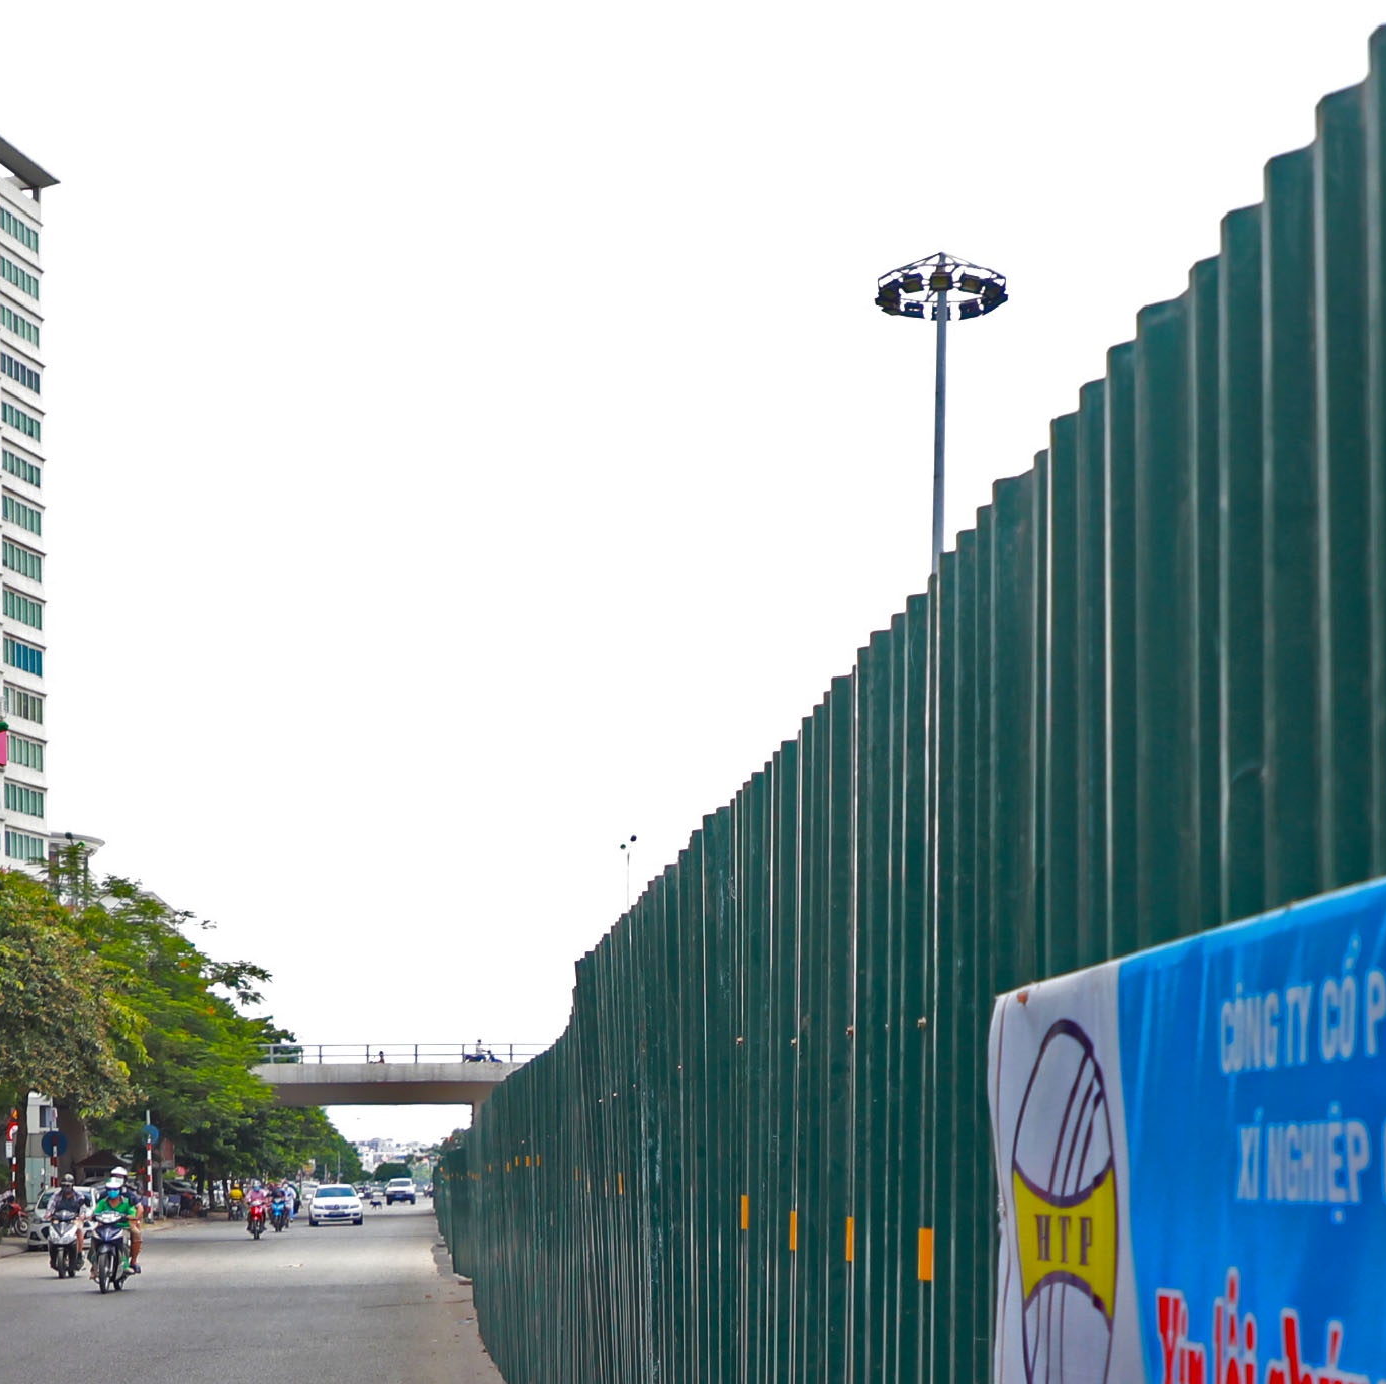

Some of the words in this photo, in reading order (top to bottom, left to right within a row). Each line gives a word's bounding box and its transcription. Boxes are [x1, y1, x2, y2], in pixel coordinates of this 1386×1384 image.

[1220, 983, 1279, 1073] CÔNG
[1285, 986, 1313, 1065] TY
[1237, 1107, 1264, 1202] XÍ
[1267, 1103, 1370, 1224] NGHIỆP
